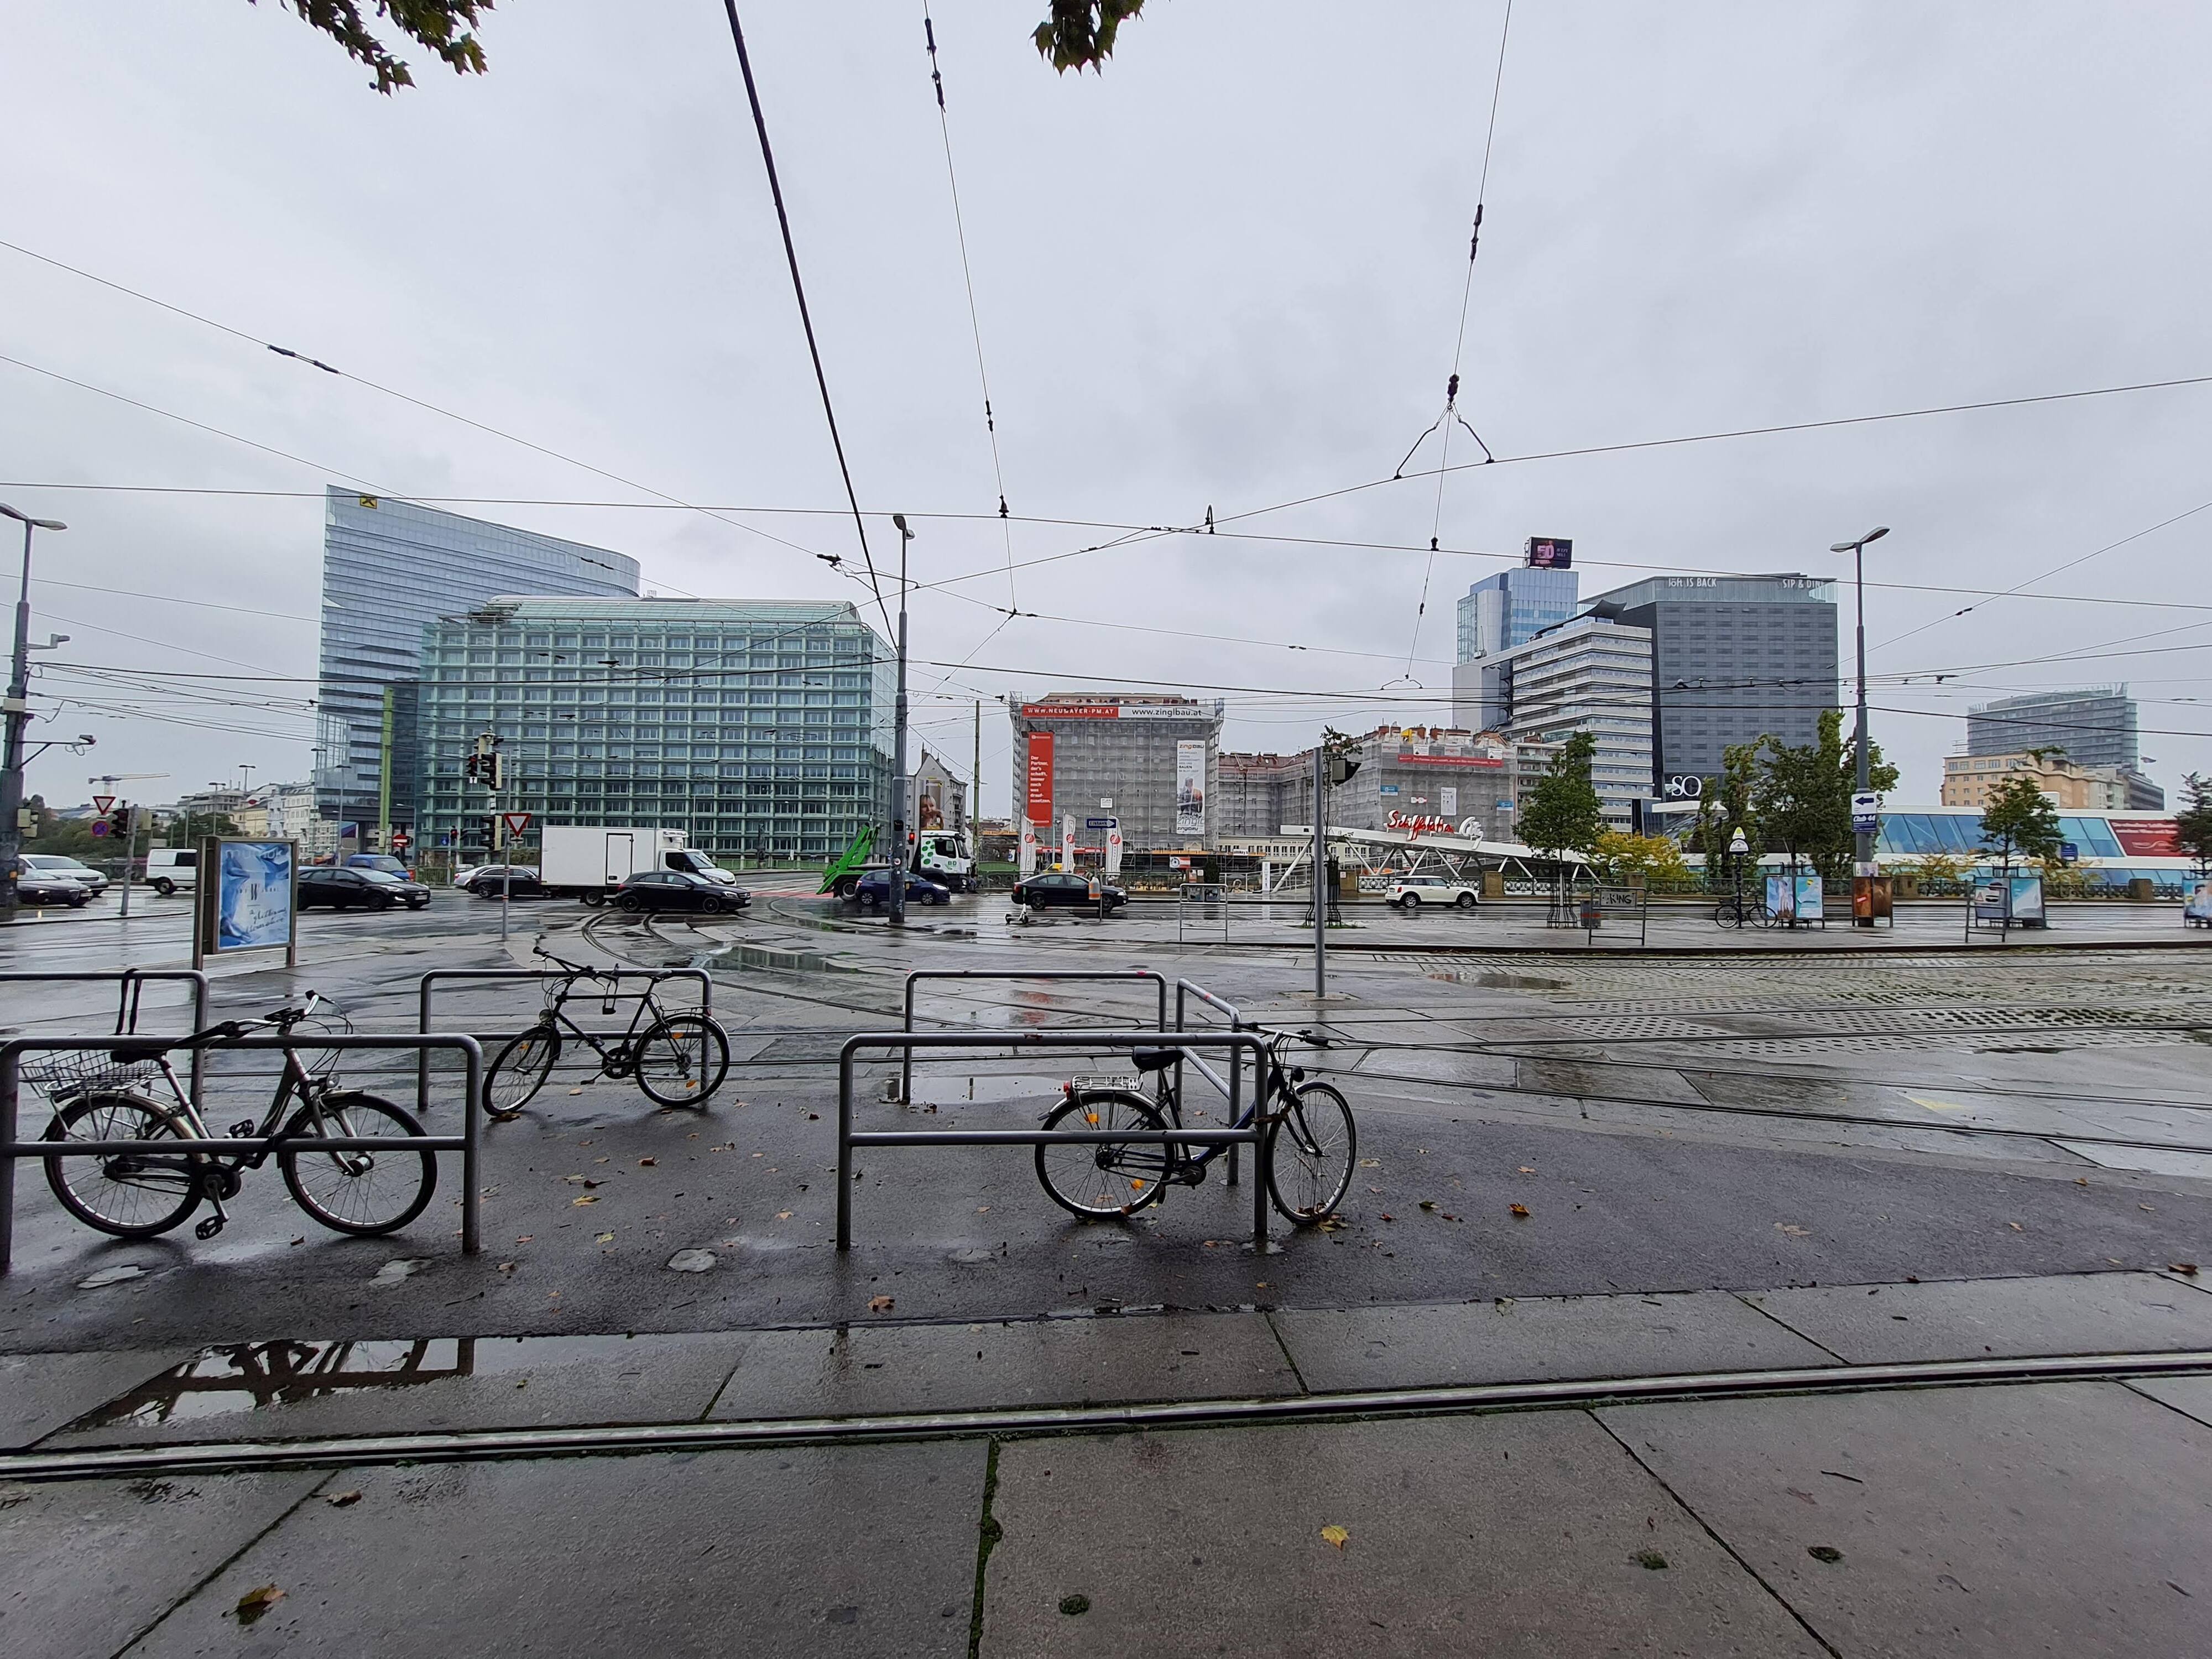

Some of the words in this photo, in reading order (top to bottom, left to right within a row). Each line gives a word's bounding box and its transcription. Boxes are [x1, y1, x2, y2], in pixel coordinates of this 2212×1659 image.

[1686, 578, 1693, 587] IS
[1697, 578, 1717, 587] BACK
[1783, 579, 1796, 588] SIP
[1798, 580, 1804, 588] &
[1131, 708, 1202, 717] www.zinglbau.at
